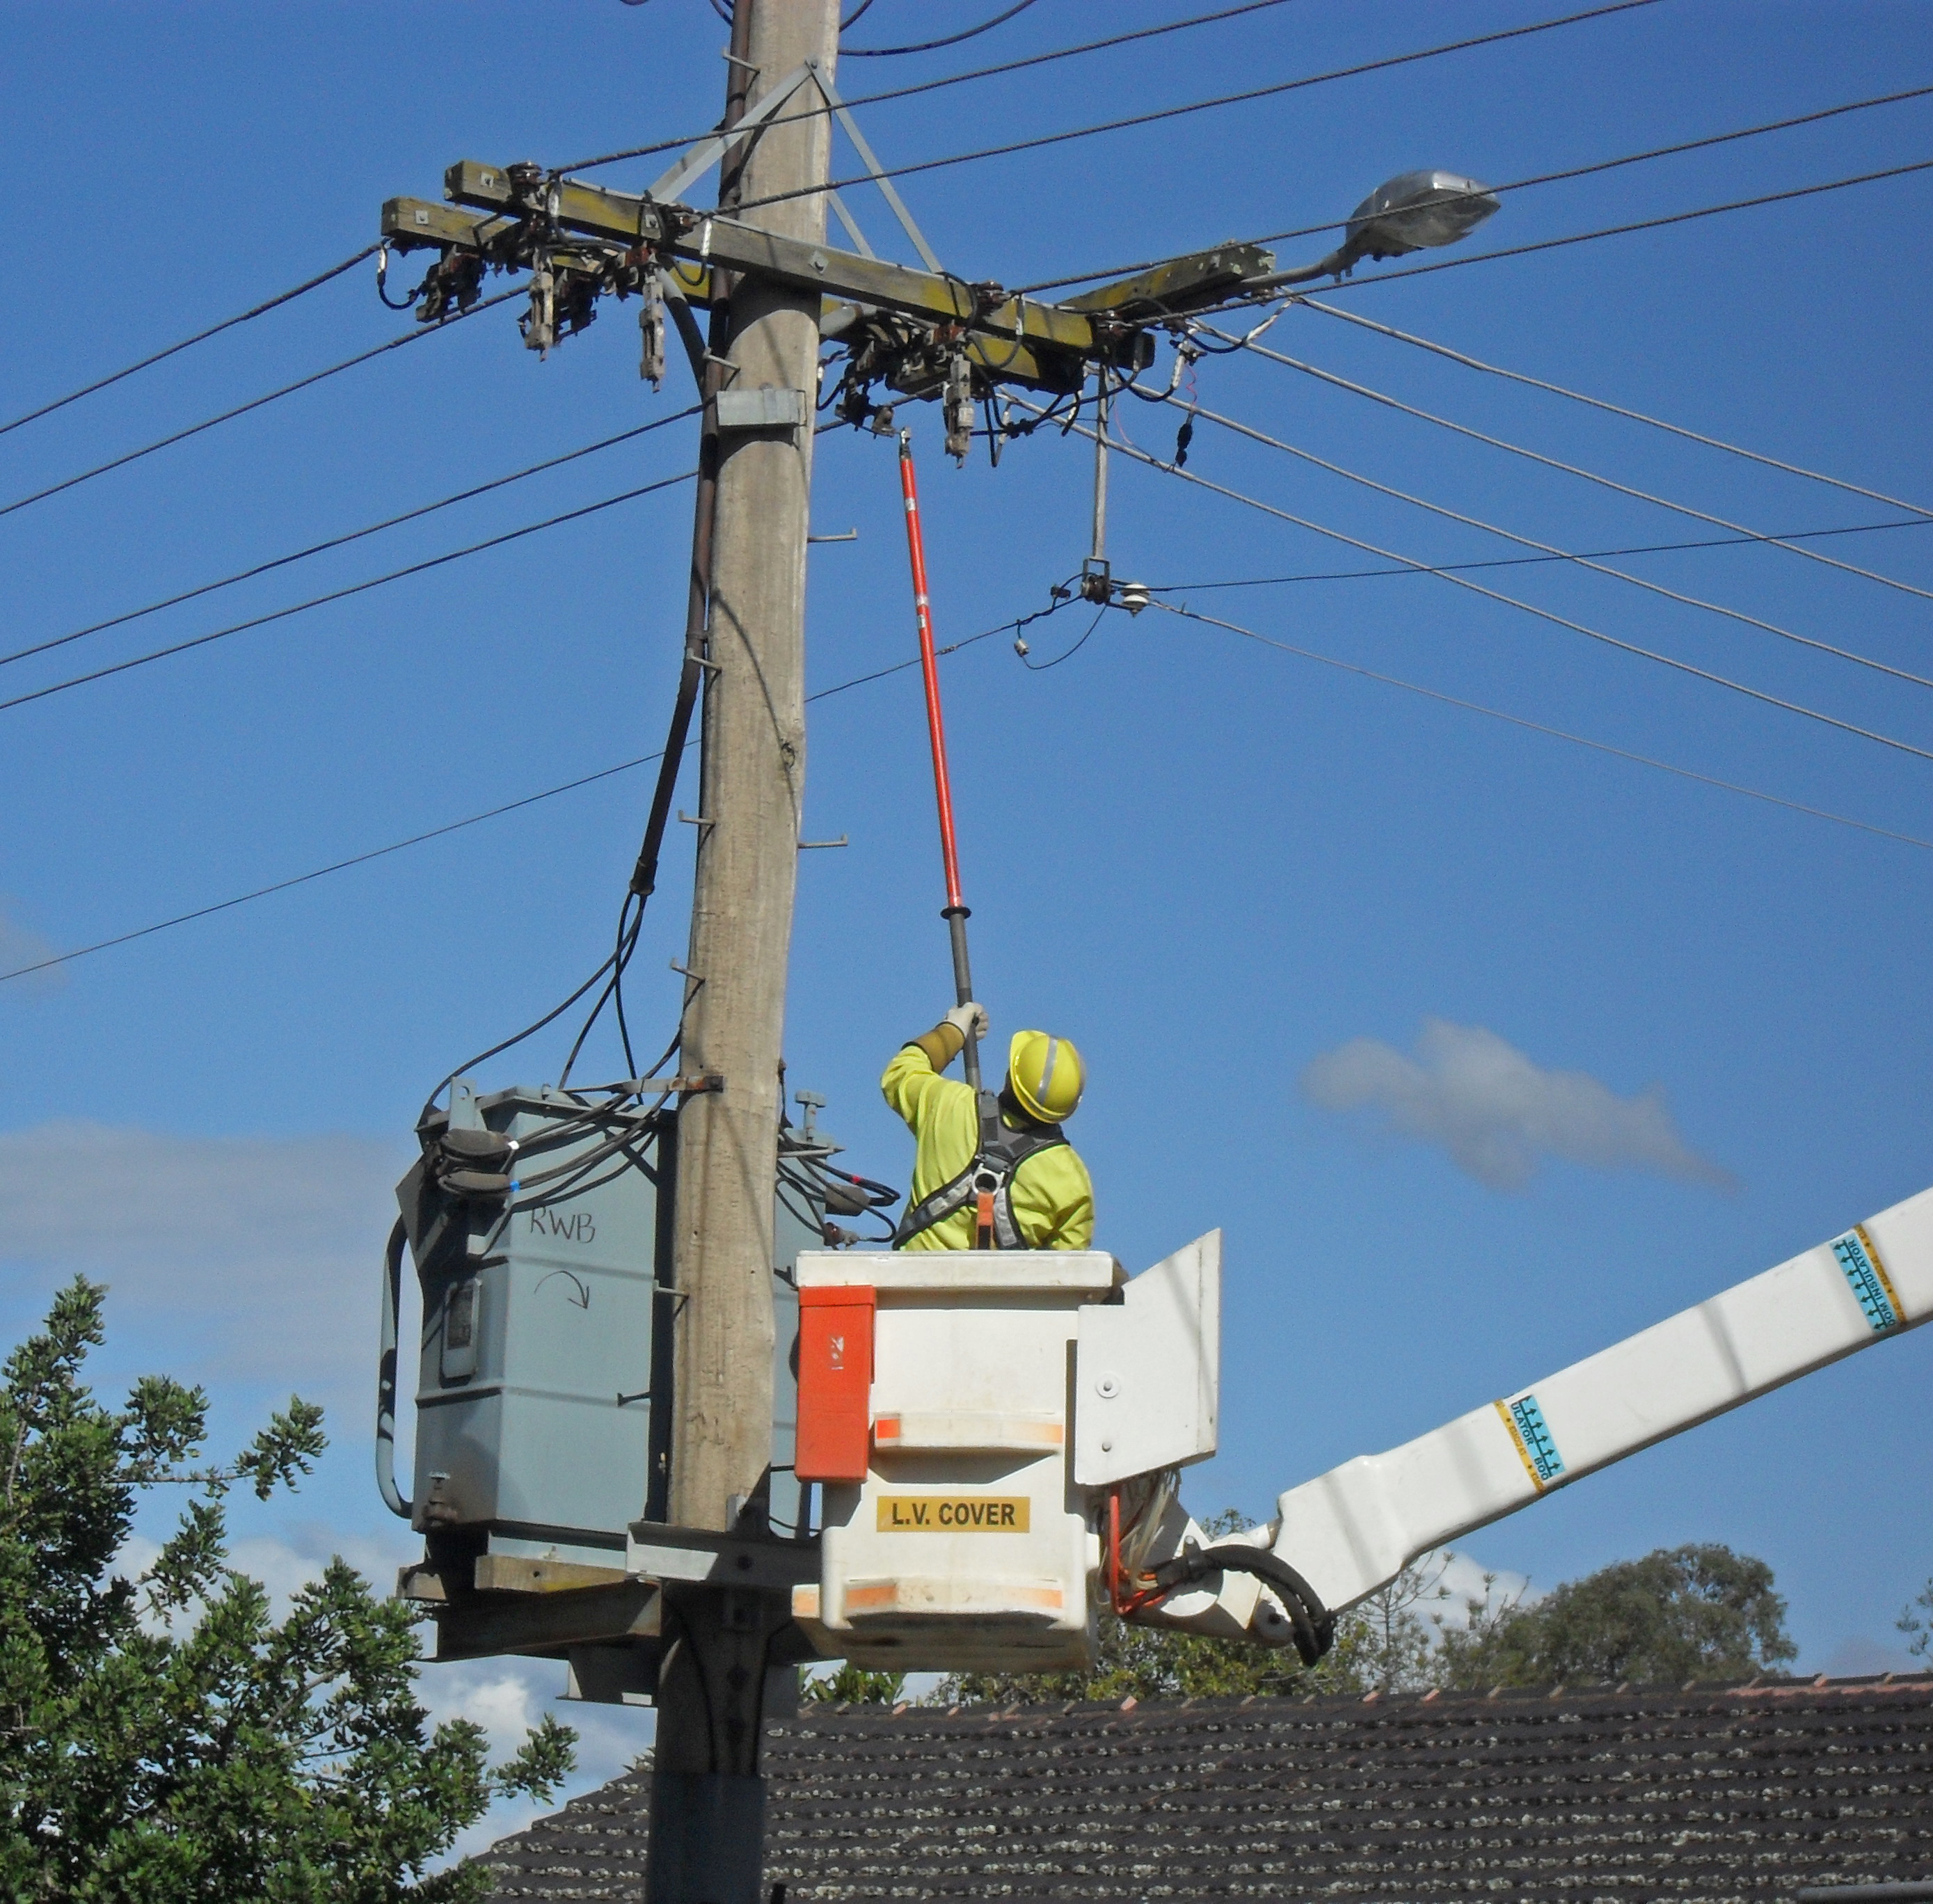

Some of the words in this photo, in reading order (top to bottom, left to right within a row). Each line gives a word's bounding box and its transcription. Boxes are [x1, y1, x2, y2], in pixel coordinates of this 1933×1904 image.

[531, 1207, 595, 1244] RWB
[1848, 1239, 1884, 1302] INSULATOR
[892, 1503, 930, 1525] L.V.
[939, 1502, 1015, 1525] COVER
